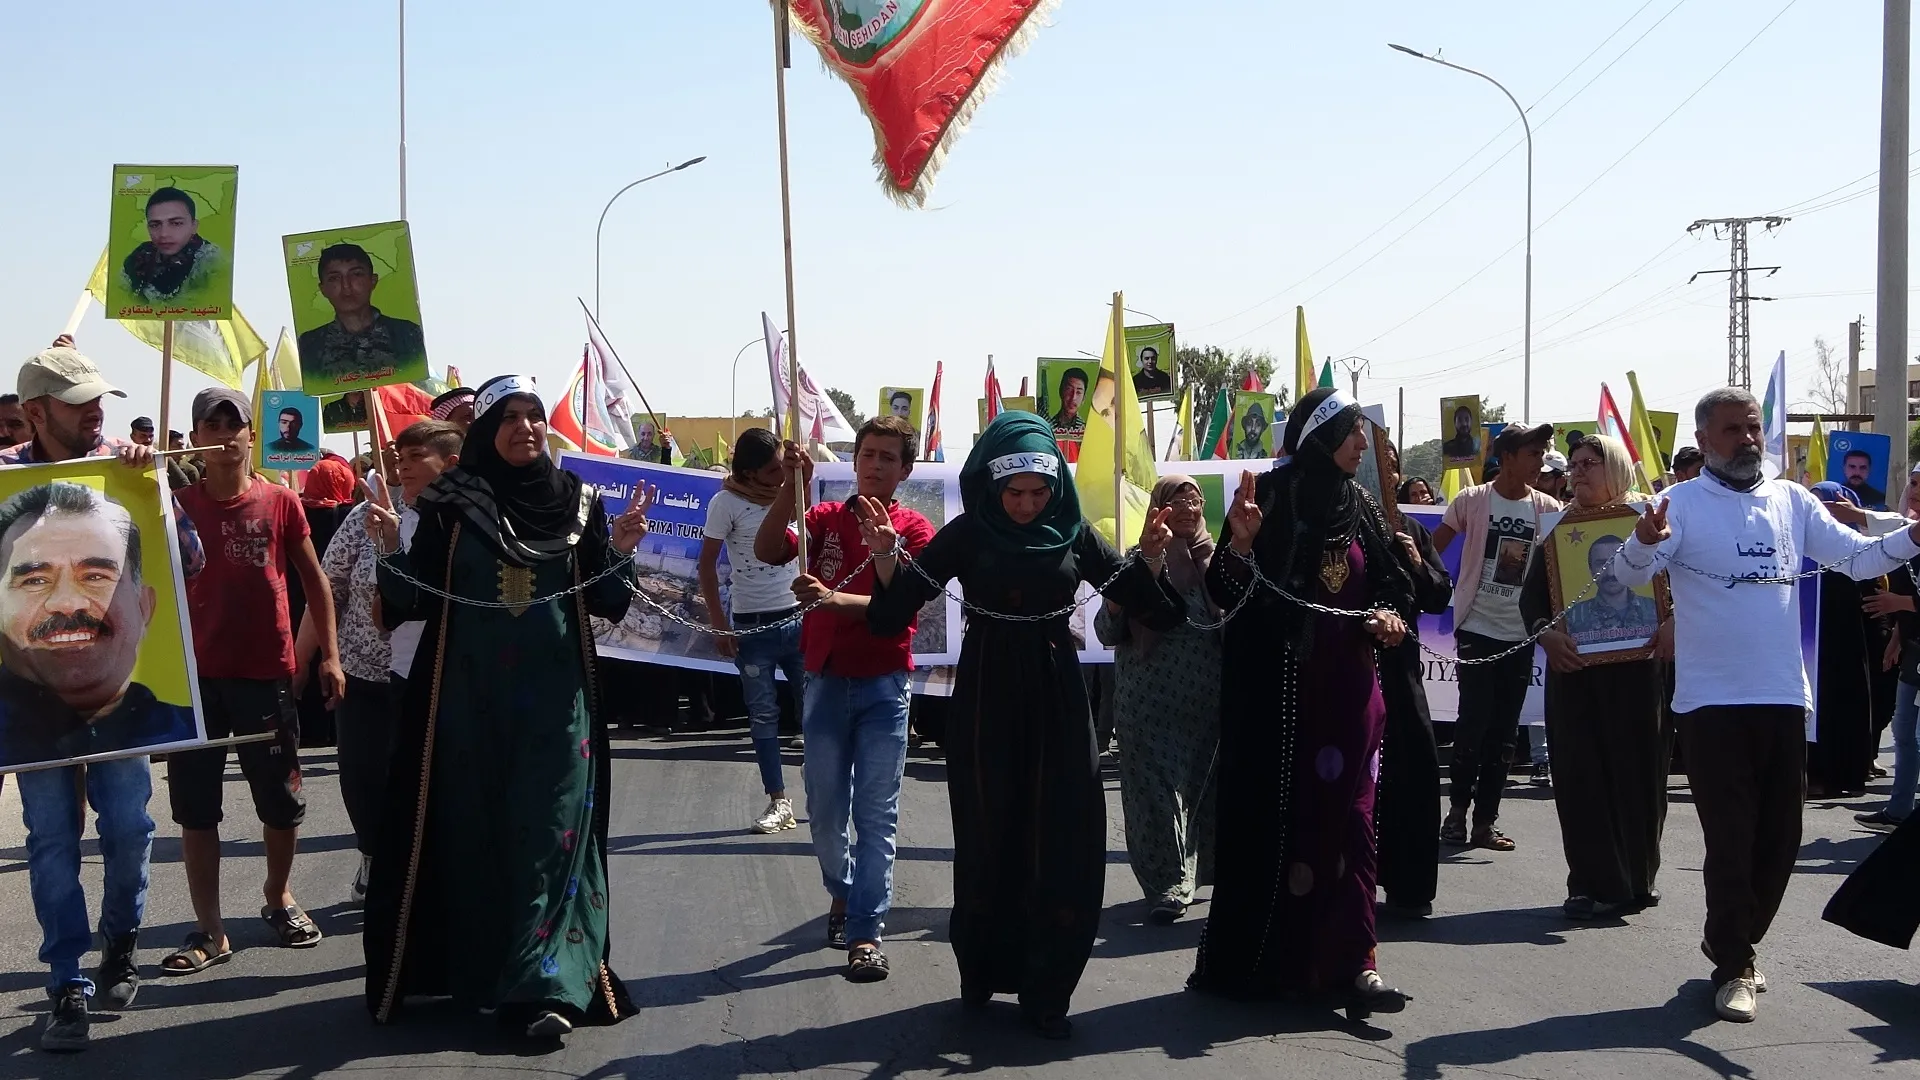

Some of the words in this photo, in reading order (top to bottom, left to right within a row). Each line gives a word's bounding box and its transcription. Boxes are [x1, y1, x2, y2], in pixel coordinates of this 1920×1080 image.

[191, 305, 221, 316] الشهيد
[364, 367, 395, 381] الشهيد
[1313, 400, 1338, 425] APO
[663, 491, 701, 510] عاشت
